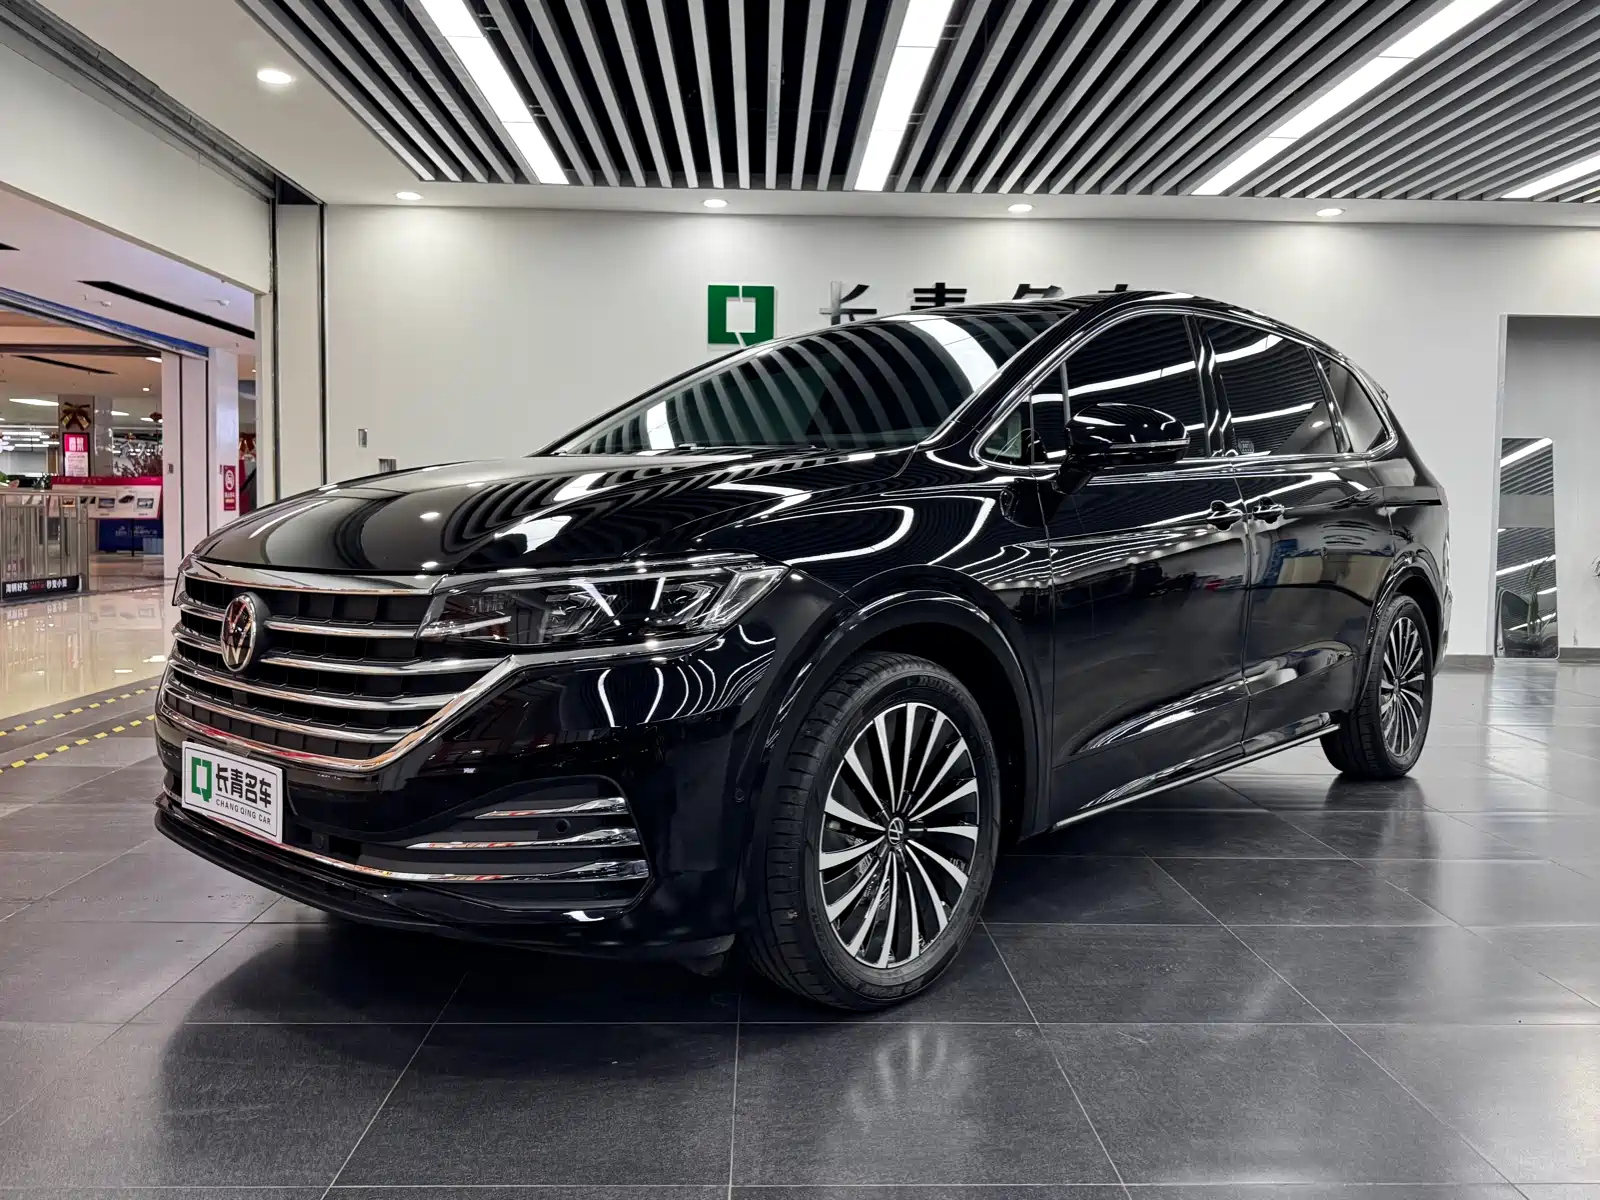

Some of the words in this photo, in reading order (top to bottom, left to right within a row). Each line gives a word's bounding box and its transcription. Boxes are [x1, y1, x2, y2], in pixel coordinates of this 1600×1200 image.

[216, 763, 271, 808] 长青名车
[216, 798, 239, 812] CHANG
[240, 807, 256, 820] QING
[258, 813, 271, 826] CAR
